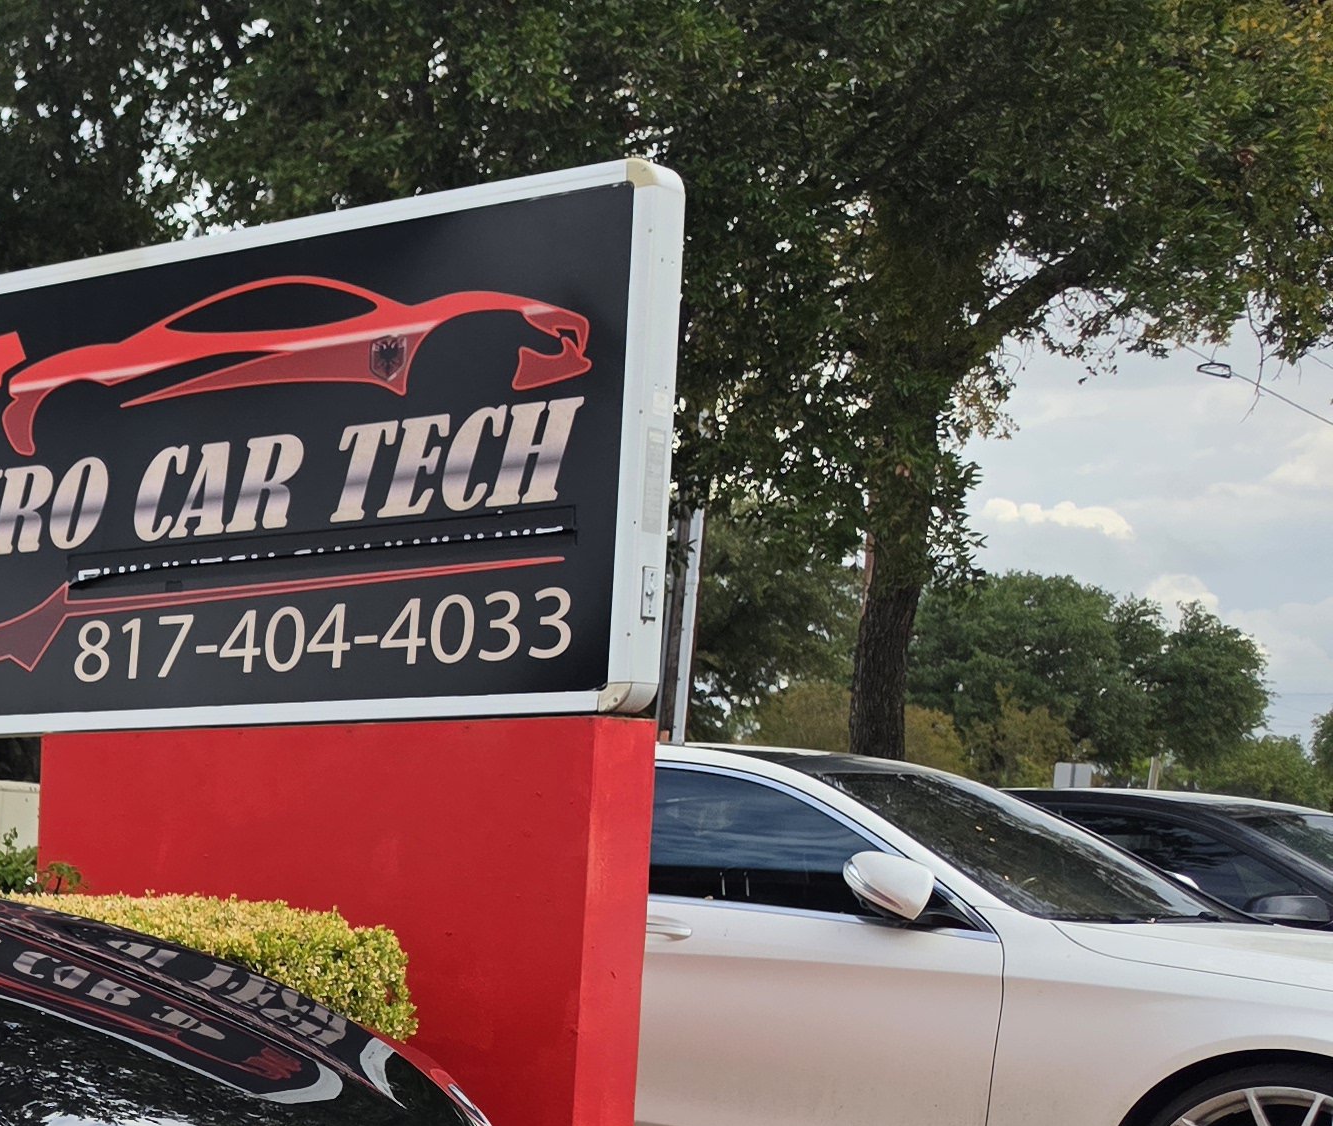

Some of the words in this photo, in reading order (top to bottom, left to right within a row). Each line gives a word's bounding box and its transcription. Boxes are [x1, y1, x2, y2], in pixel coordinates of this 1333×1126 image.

[134, 434, 305, 541] CAR
[330, 396, 585, 523] TECH
[74, 587, 572, 683] 817-404-4033
